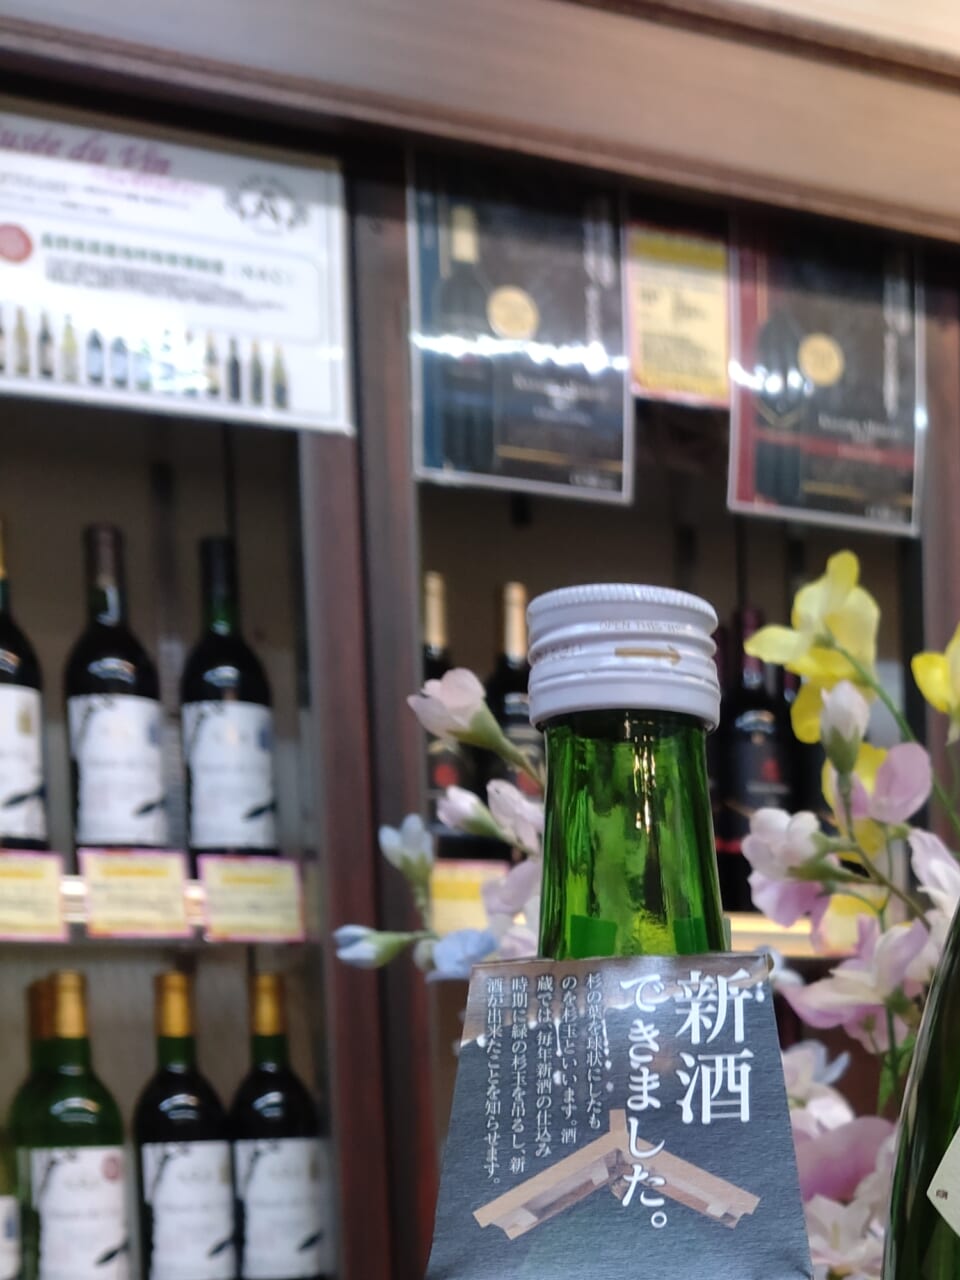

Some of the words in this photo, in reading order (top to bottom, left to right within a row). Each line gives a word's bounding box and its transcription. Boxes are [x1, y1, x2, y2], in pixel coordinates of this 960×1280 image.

[620, 974, 668, 1229] できました。
[674, 968, 754, 1125] 新酒
